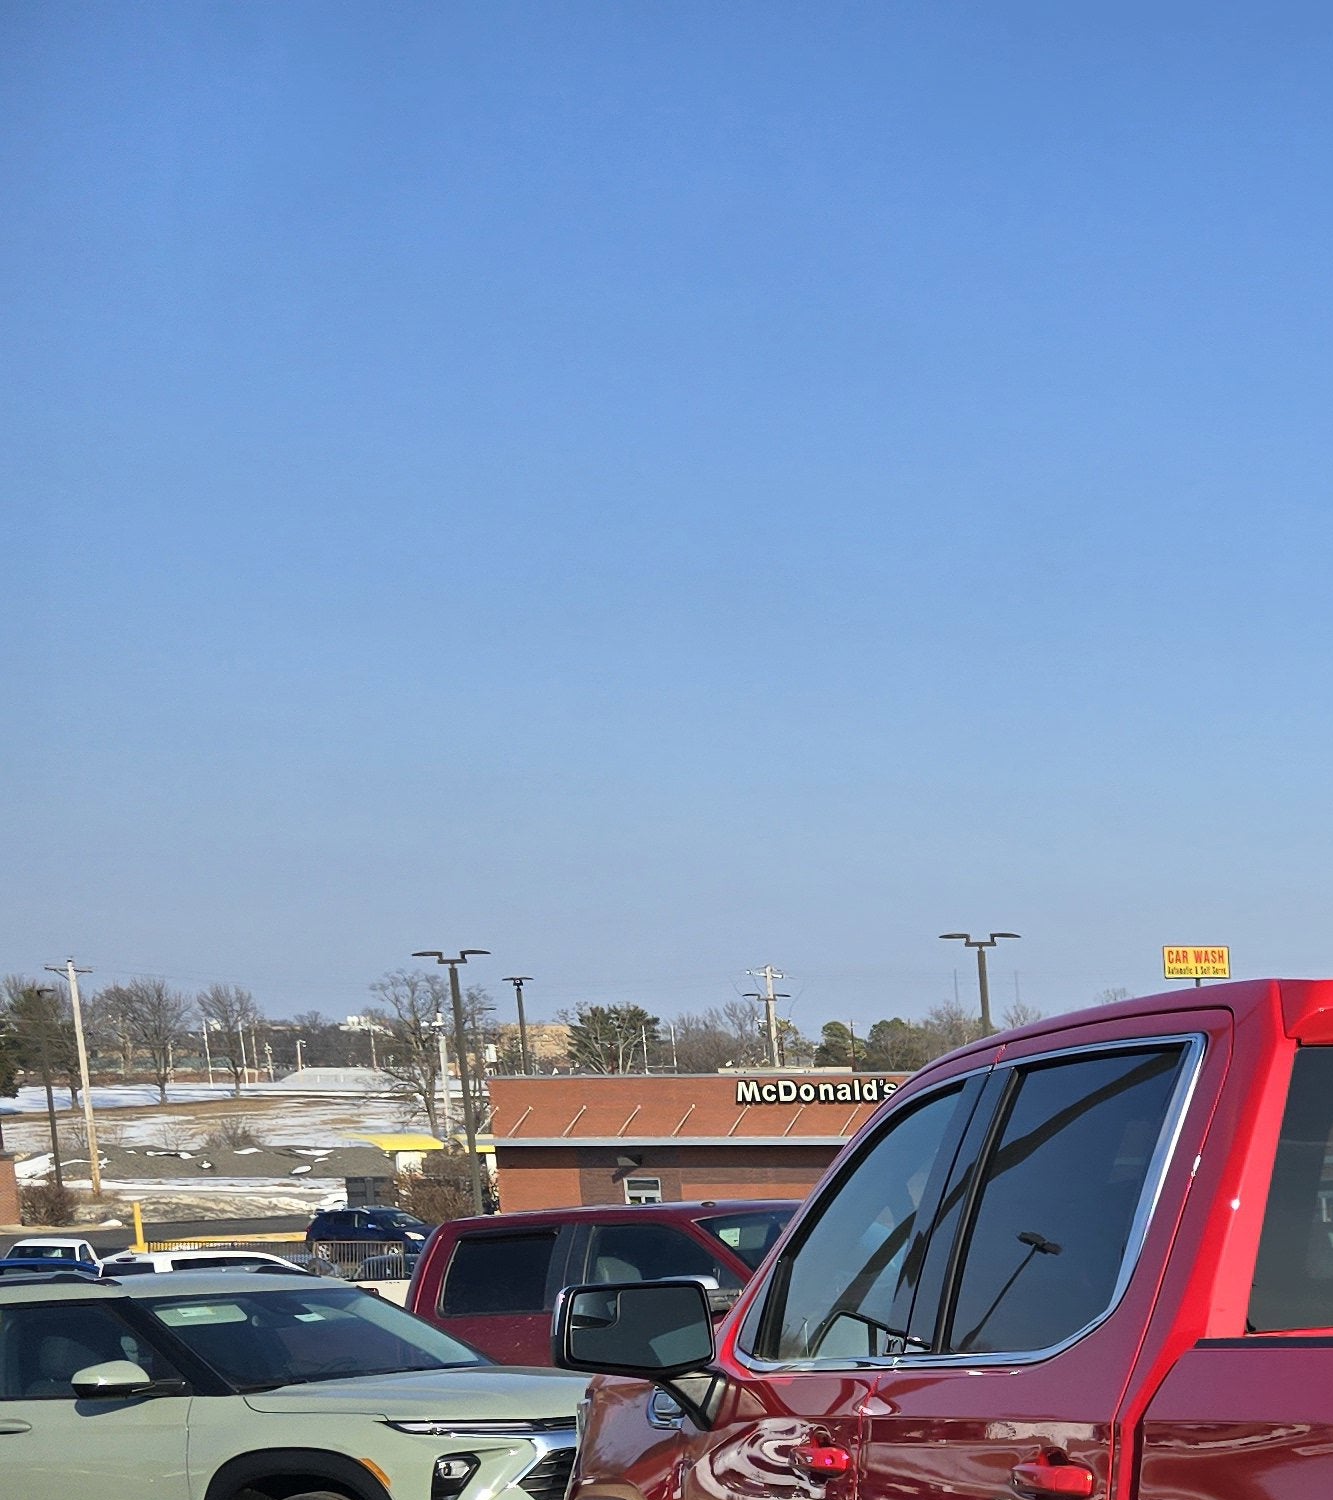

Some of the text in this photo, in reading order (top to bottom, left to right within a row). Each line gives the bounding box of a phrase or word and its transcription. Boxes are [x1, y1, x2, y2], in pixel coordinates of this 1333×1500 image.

[1168, 950, 1225, 964] CAR WASH
[737, 1079, 898, 1103] McDonald's
